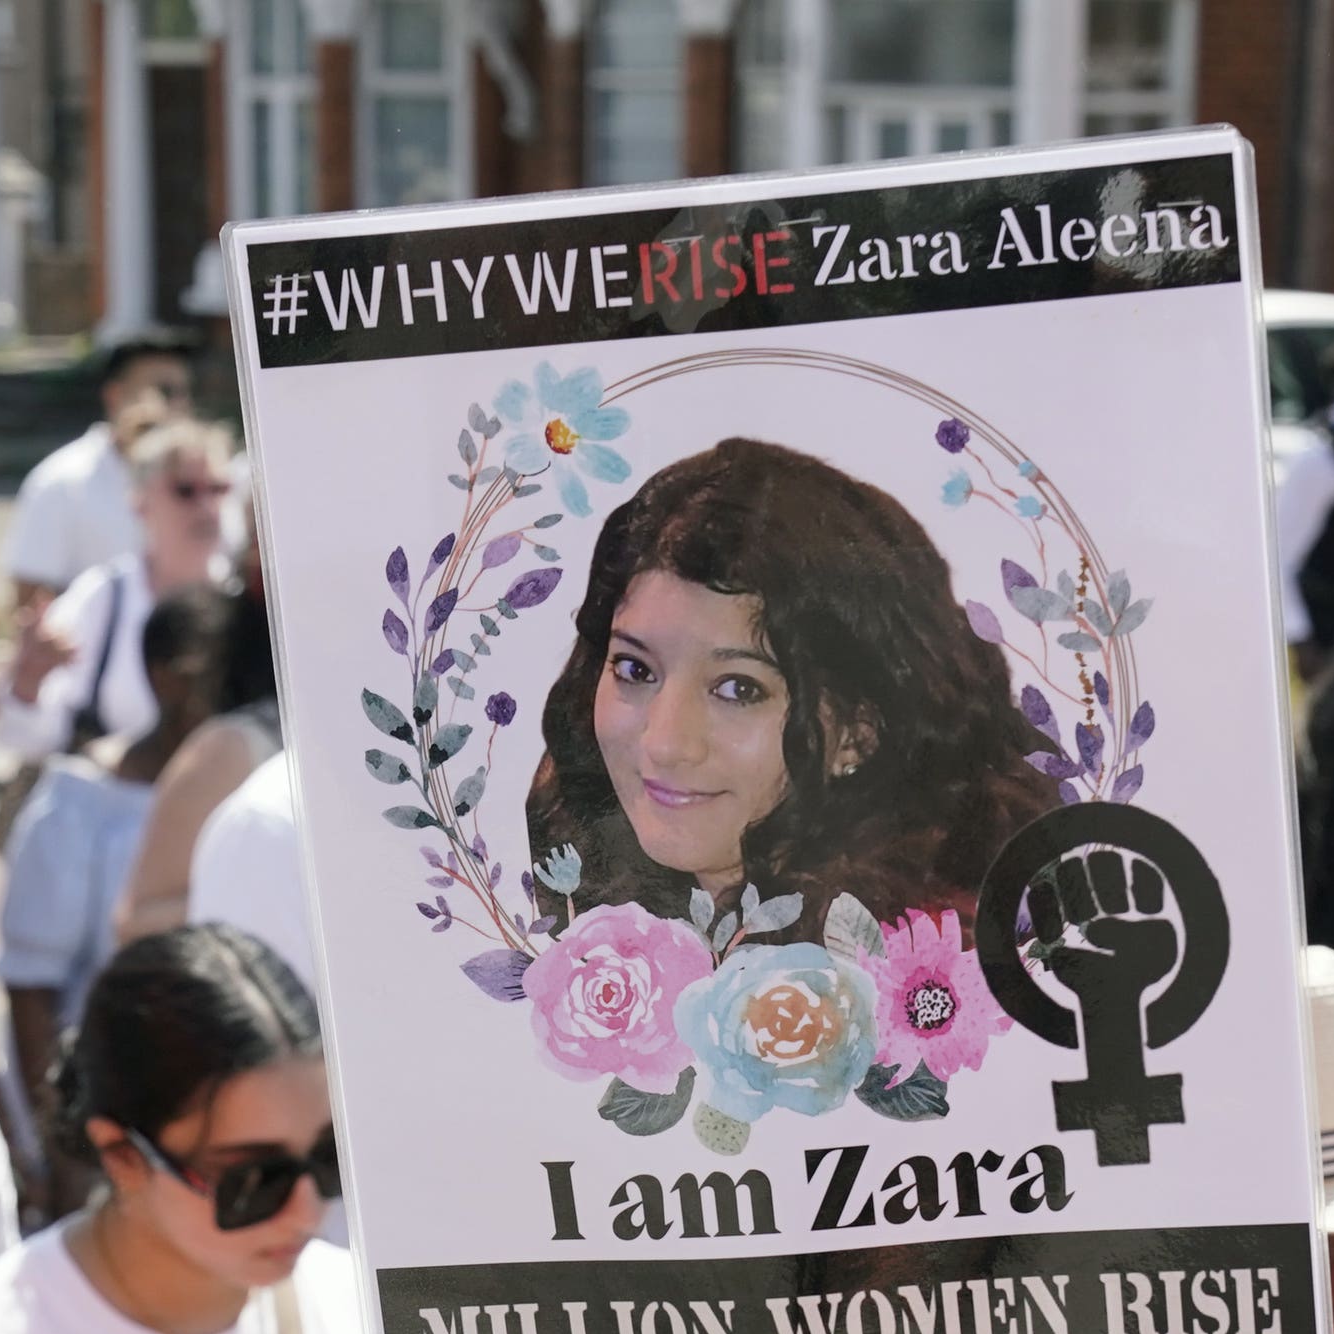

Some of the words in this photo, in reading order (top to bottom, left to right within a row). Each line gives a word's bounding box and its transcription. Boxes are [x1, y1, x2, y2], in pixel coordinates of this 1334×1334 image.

[811, 223, 970, 287] Zara
[986, 202, 1230, 270] Aleena
[540, 1161, 586, 1241] I
[608, 1168, 782, 1241] am
[804, 1144, 1076, 1232] Zara
